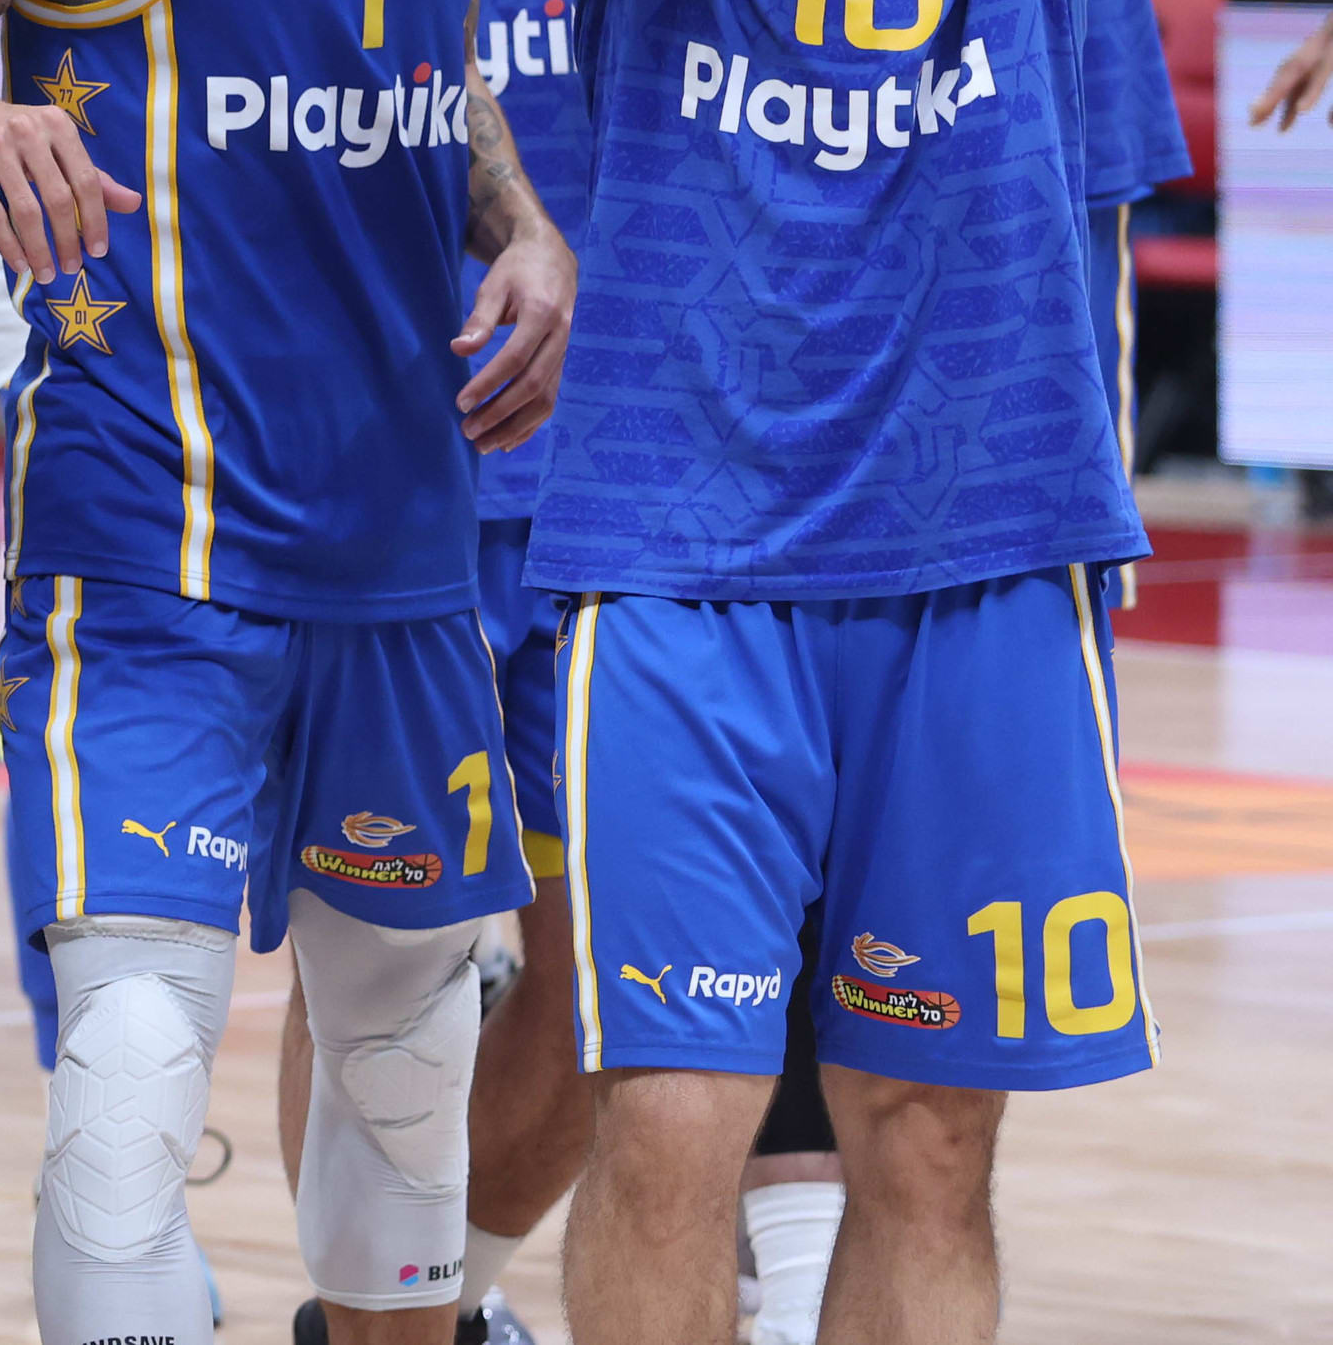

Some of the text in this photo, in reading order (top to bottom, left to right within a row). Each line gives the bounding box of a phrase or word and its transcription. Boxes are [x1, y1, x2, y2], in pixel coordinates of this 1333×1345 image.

[59, 88, 73, 104] 77
[680, 37, 997, 171] Playtka
[75, 310, 86, 325] 01
[448, 751, 491, 876] 1
[317, 853, 403, 882] Winner
[967, 891, 1136, 1039] 10
[688, 965, 782, 1007] Rapyd
[844, 983, 918, 1020] Winner
